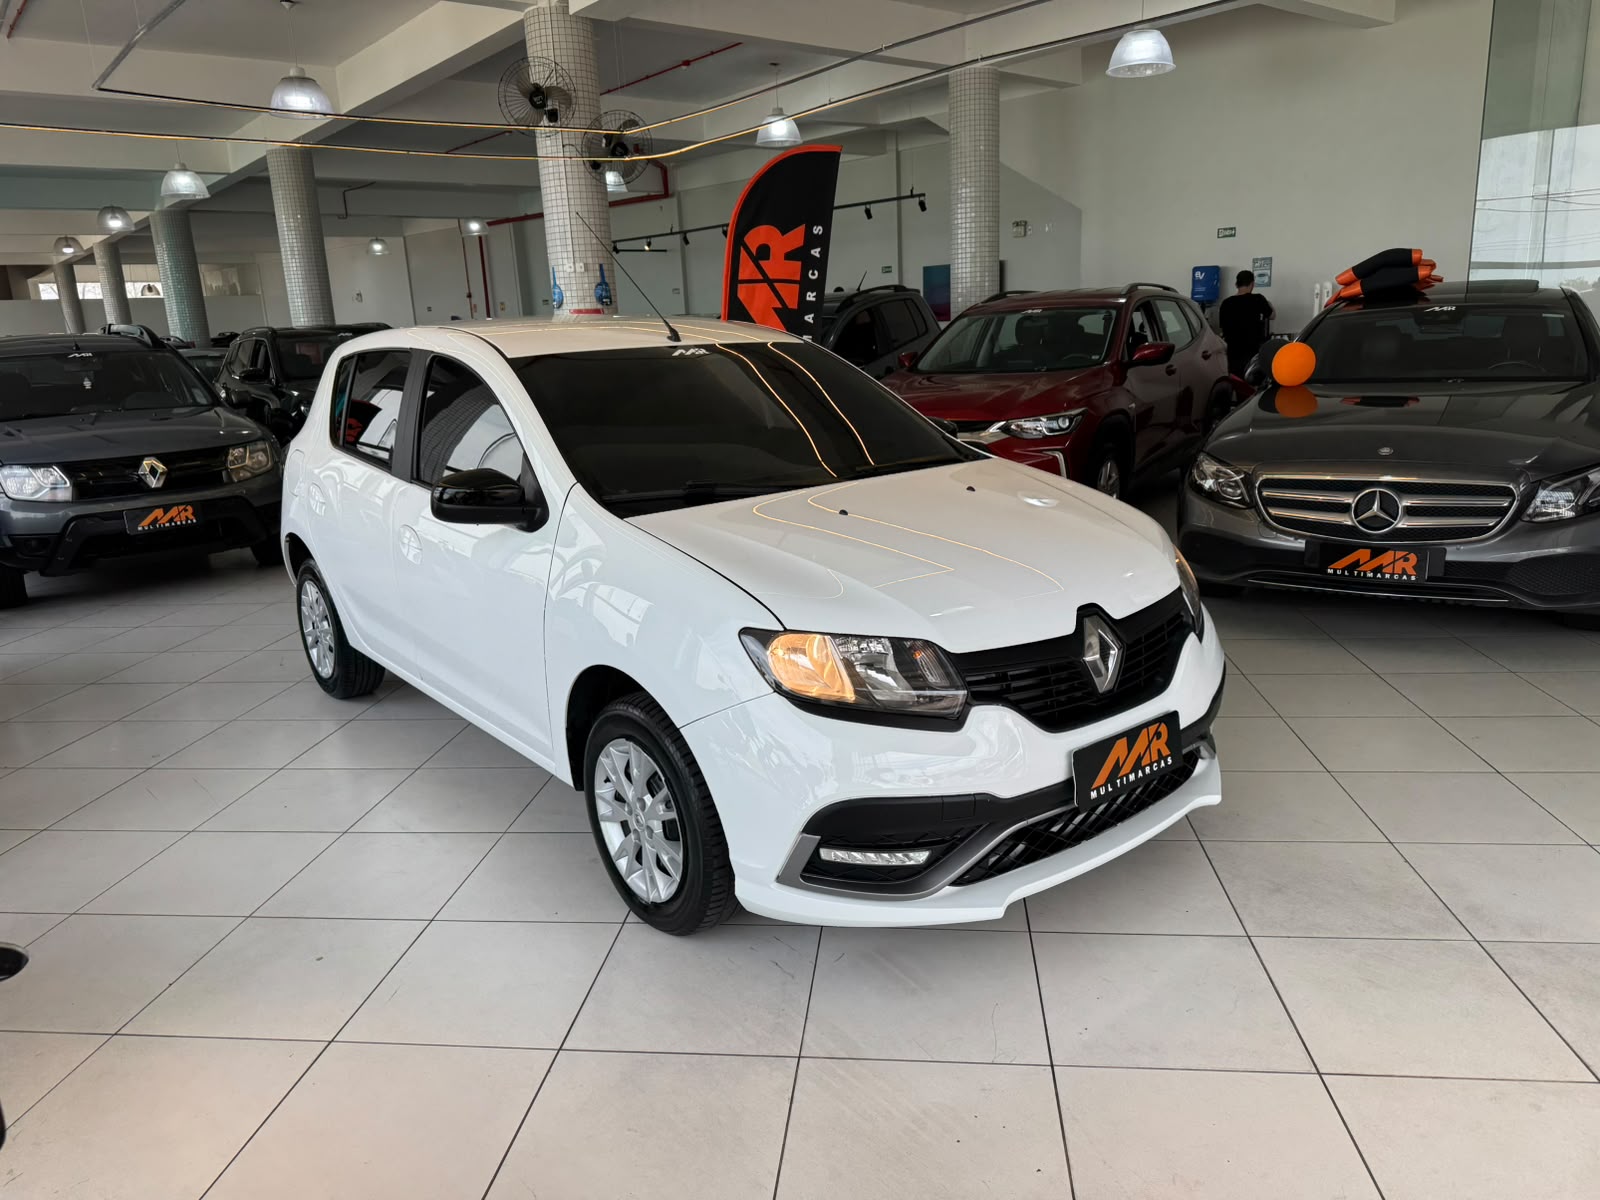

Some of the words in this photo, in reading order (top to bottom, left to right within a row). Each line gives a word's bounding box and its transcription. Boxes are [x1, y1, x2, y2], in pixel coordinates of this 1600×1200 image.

[137, 519, 197, 531] MULTIMARCAS
[1327, 568, 1417, 581] MULTIMARCAS
[1090, 756, 1173, 800] MULTIMARCAS
